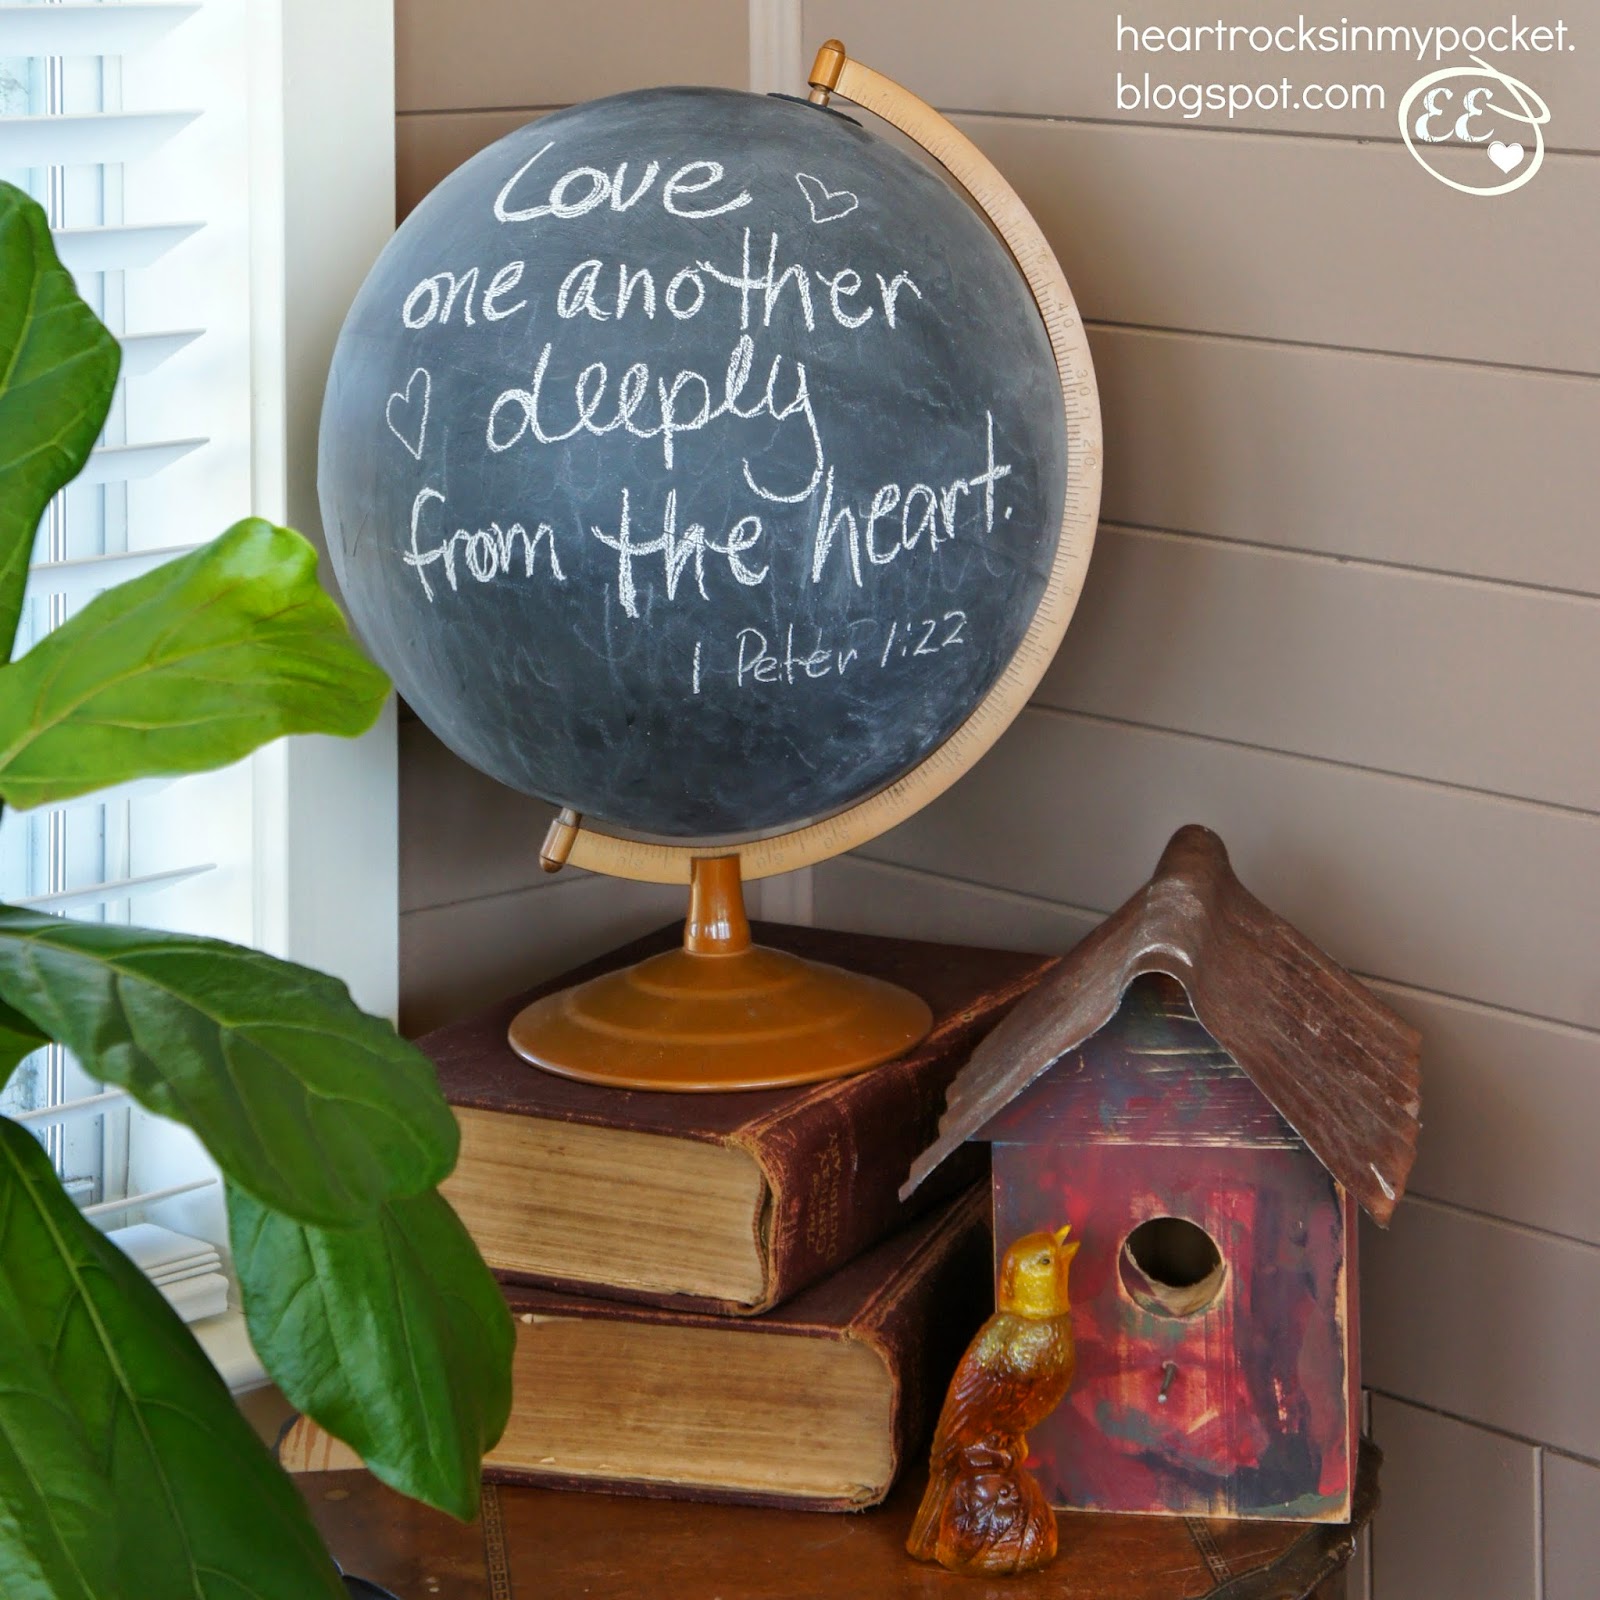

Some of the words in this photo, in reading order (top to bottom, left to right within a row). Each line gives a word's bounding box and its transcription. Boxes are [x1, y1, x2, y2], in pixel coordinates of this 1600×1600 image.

[493, 141, 752, 221] Love
[402, 260, 527, 329] one
[557, 226, 922, 331] another
[486, 334, 825, 504] deeply
[1076, 369, 1092, 398] 30
[1082, 439, 1096, 466] 20
[403, 487, 566, 603] from
[591, 487, 769, 618] the
[811, 409, 1013, 588] heart.
[736, 622, 859, 688] Peter
[880, 610, 968, 669] 1:22
